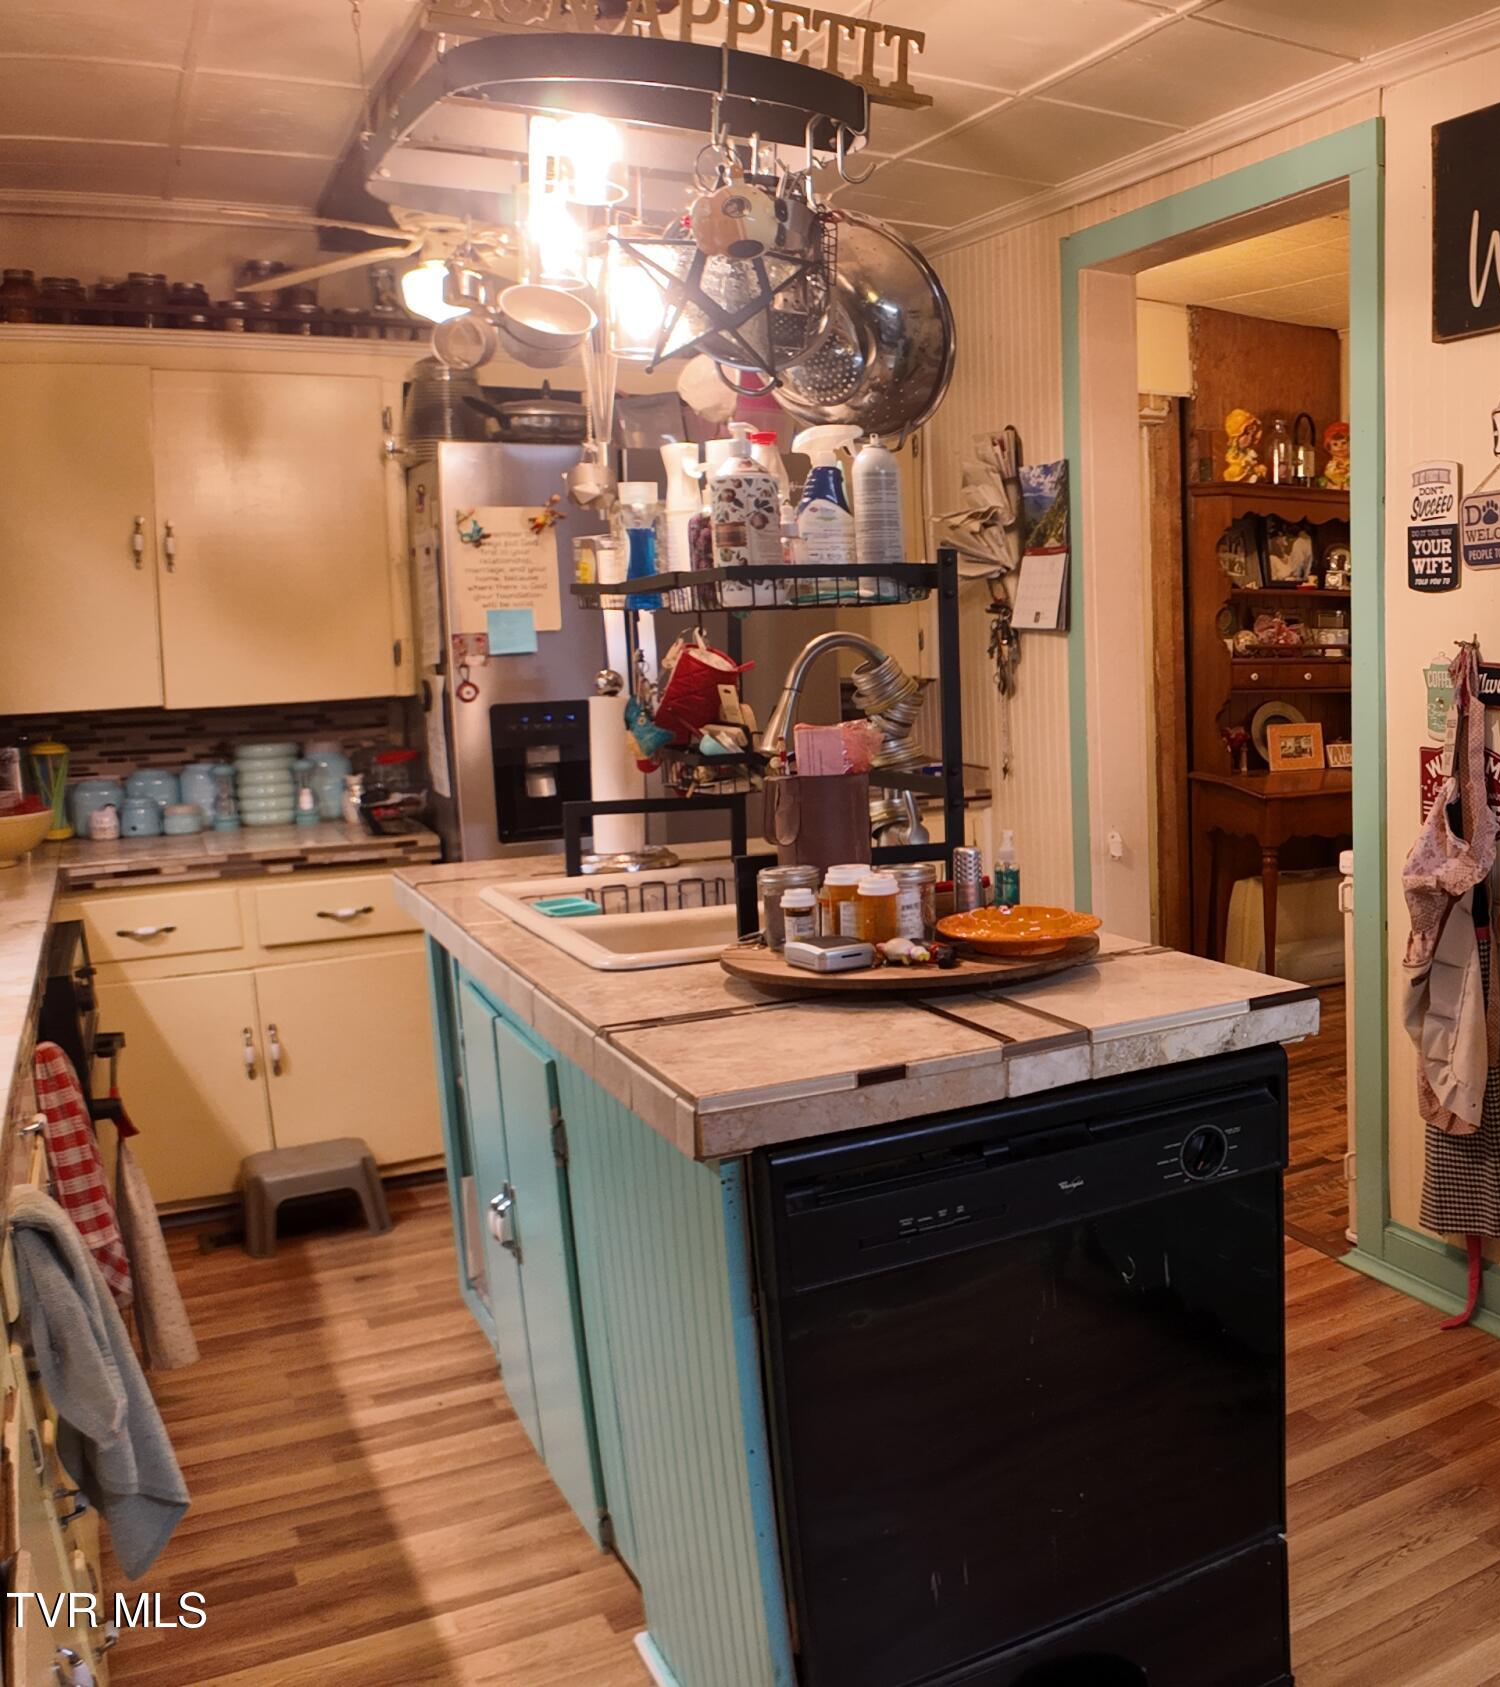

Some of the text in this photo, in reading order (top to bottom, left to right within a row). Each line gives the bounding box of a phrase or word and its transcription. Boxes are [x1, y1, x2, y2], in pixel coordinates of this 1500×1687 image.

[1419, 485, 1445, 496] DON'T
[1412, 538, 1452, 555] YOUR
[1468, 548, 1494, 560] PEOPLE
[1412, 556, 1452, 574] WIFE
